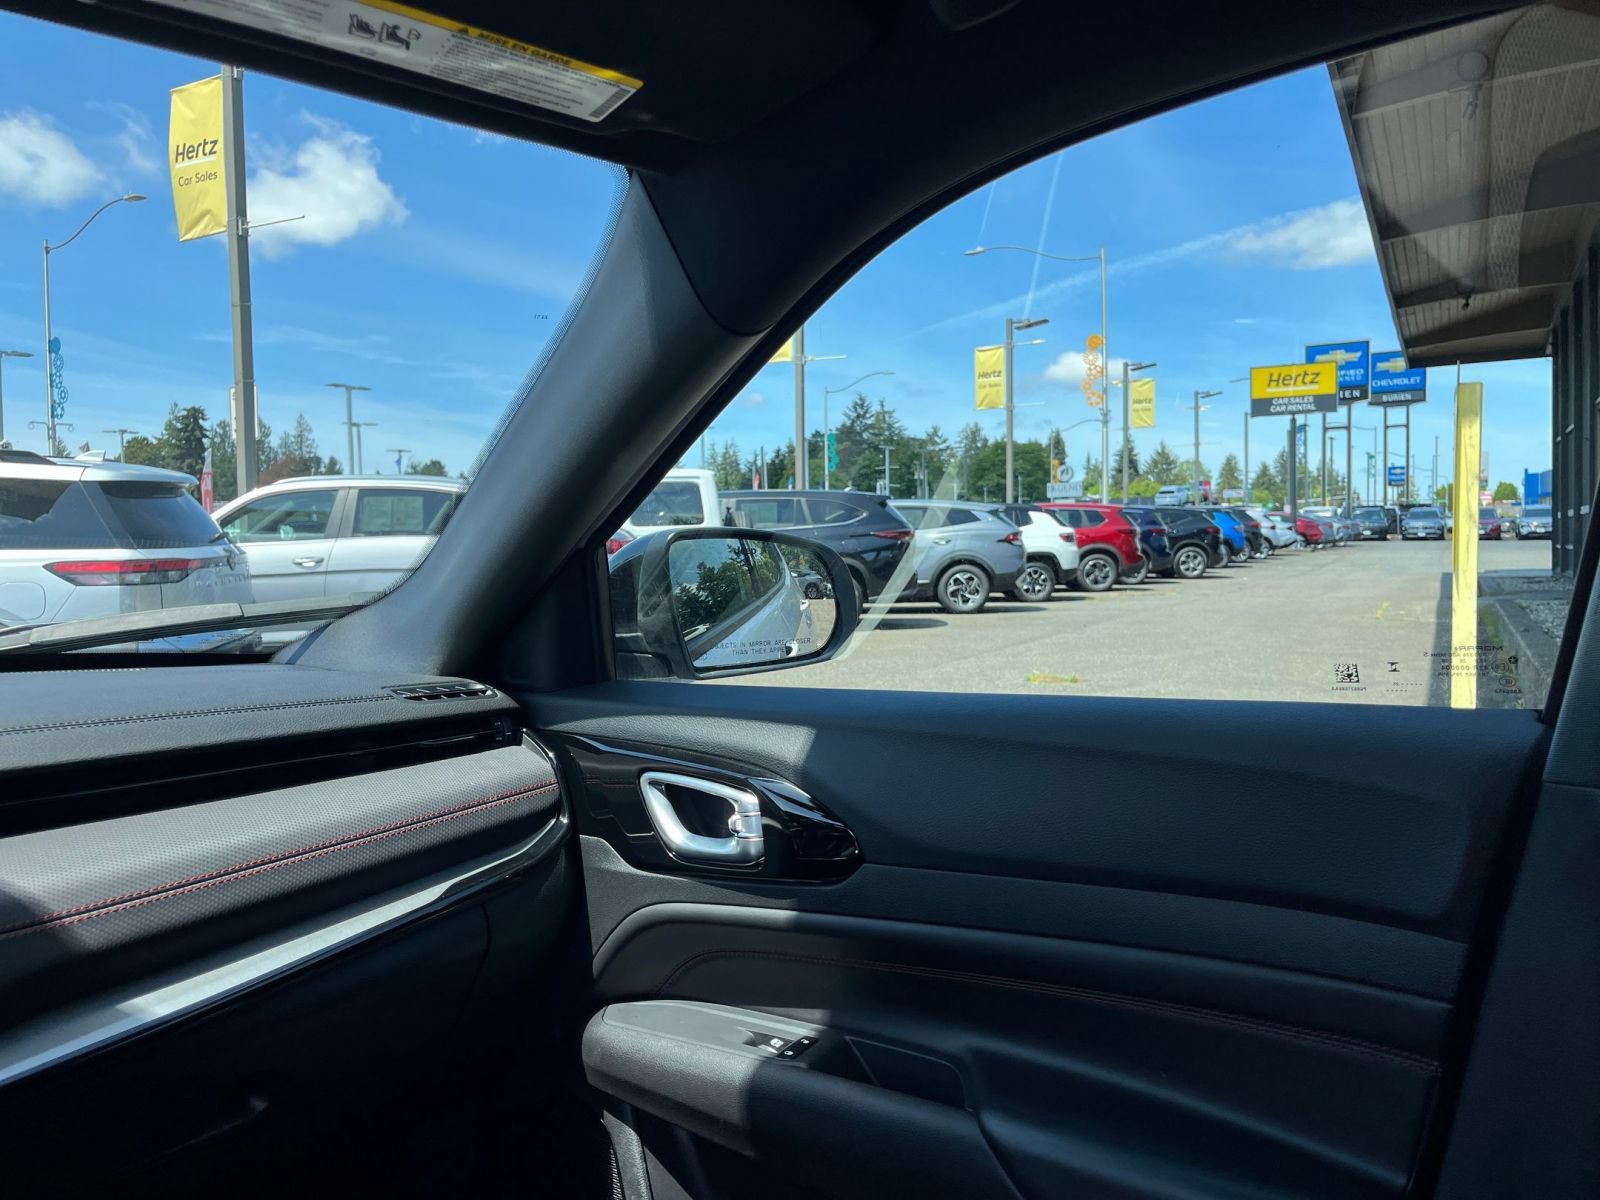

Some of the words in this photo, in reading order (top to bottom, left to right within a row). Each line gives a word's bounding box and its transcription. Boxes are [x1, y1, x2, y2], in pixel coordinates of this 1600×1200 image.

[478, 32, 508, 46] MISE
[511, 42, 529, 53] EN
[532, 48, 572, 65] GARDE
[175, 138, 219, 163] Hertz
[178, 176, 193, 187] Car
[194, 171, 218, 184] Sales
[977, 370, 1003, 380] Hertz
[1267, 369, 1321, 388] Hertz
[1372, 376, 1421, 387] CHEVROLET
[1132, 397, 1153, 405] Hertz
[1272, 397, 1289, 405] CAR
[1289, 395, 1314, 404] SALES
[1382, 392, 1412, 402] BURIEN
[1270, 404, 1287, 413] CAR
[1287, 403, 1317, 411] RENTAL
[749, 639, 771, 648] MIRROR
[732, 648, 748, 656] THAN
[751, 647, 767, 655] THEY
